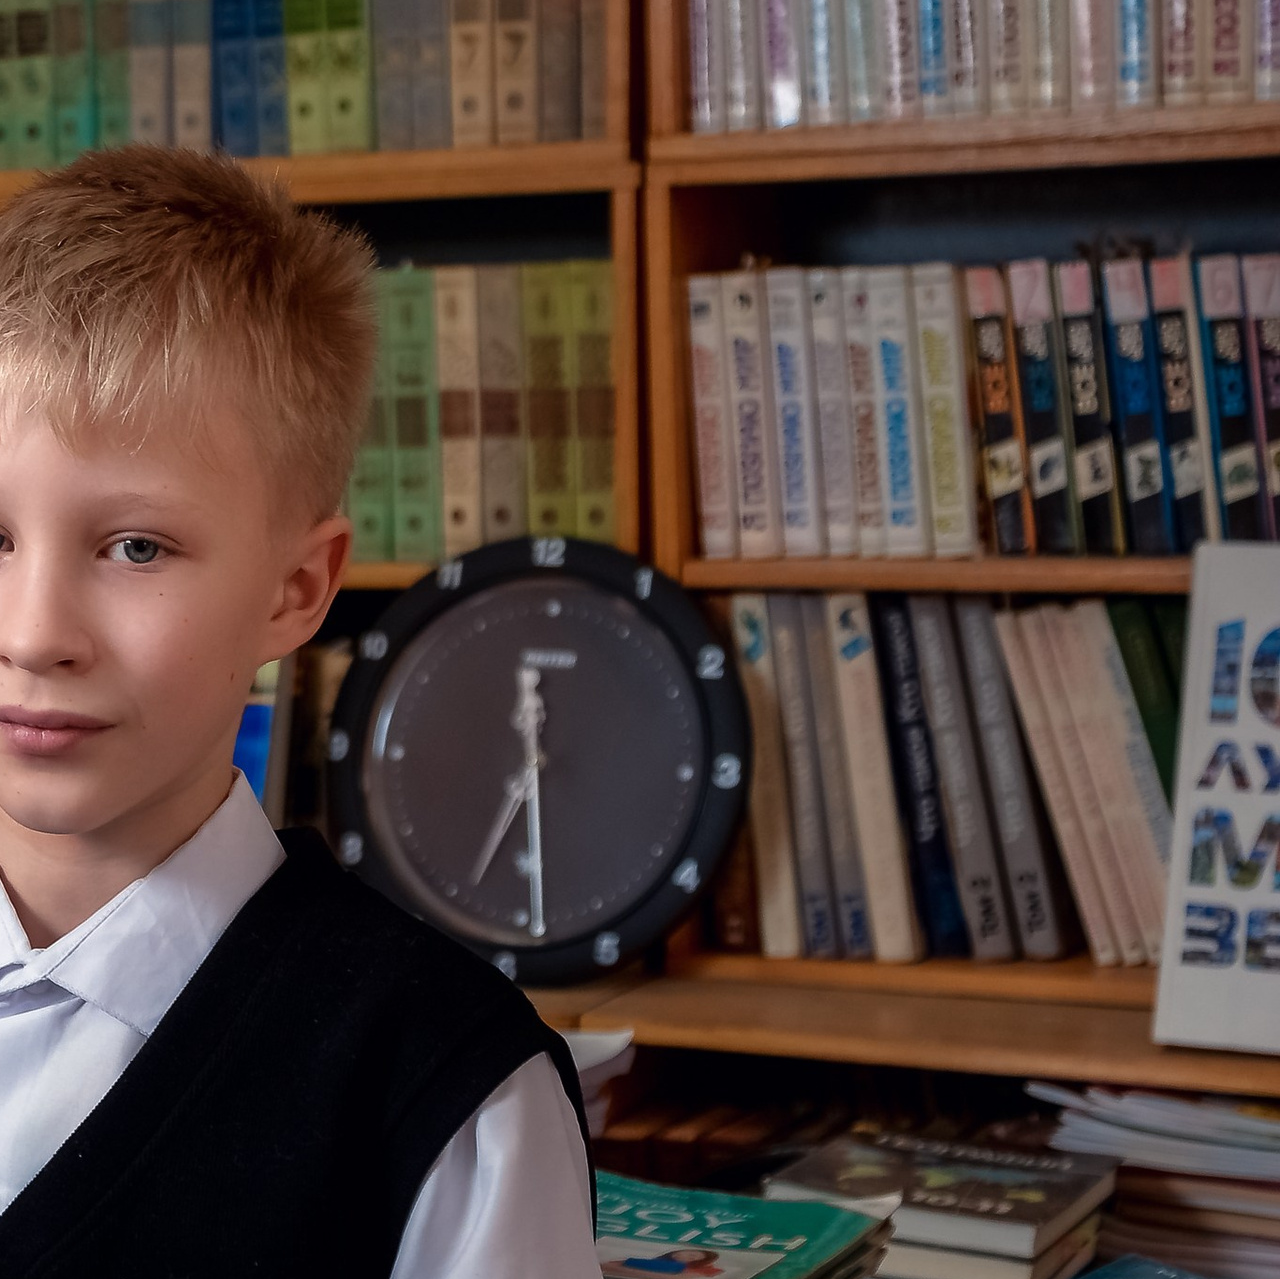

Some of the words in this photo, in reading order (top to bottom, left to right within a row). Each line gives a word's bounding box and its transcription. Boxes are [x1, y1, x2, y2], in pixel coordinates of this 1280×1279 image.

[531, 537, 566, 567] 12
[438, 561, 464, 590] 11
[634, 567, 653, 600] 1
[697, 645, 726, 679] 2
[894, 680, 922, 722] Кто
[711, 752, 741, 789] 3
[914, 798, 940, 842] Что
[671, 858, 700, 893] 4
[978, 893, 1001, 938] Том
[1024, 889, 1047, 933] Том
